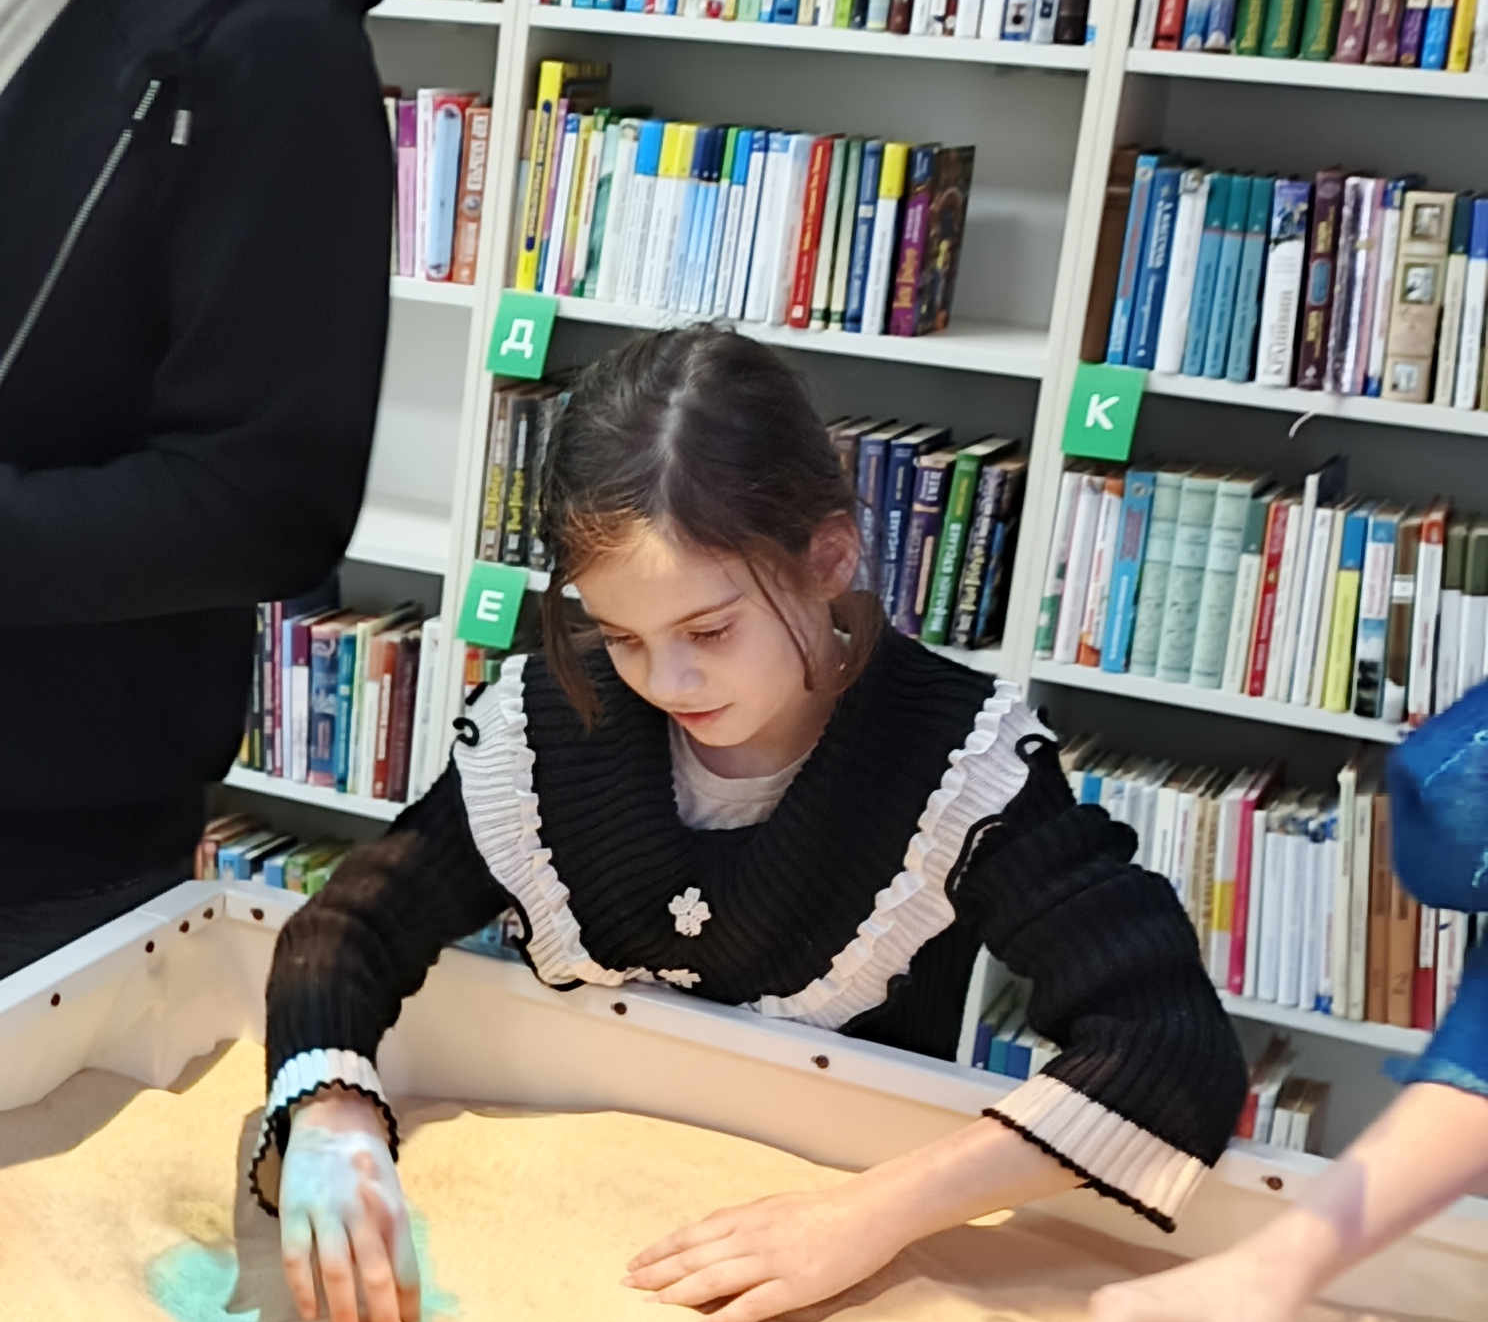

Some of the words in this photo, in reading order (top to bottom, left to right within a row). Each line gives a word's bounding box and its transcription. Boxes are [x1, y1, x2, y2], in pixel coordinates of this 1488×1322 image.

[500, 318, 535, 359] Д
[1085, 393, 1120, 430] К
[476, 589, 505, 622] Е
